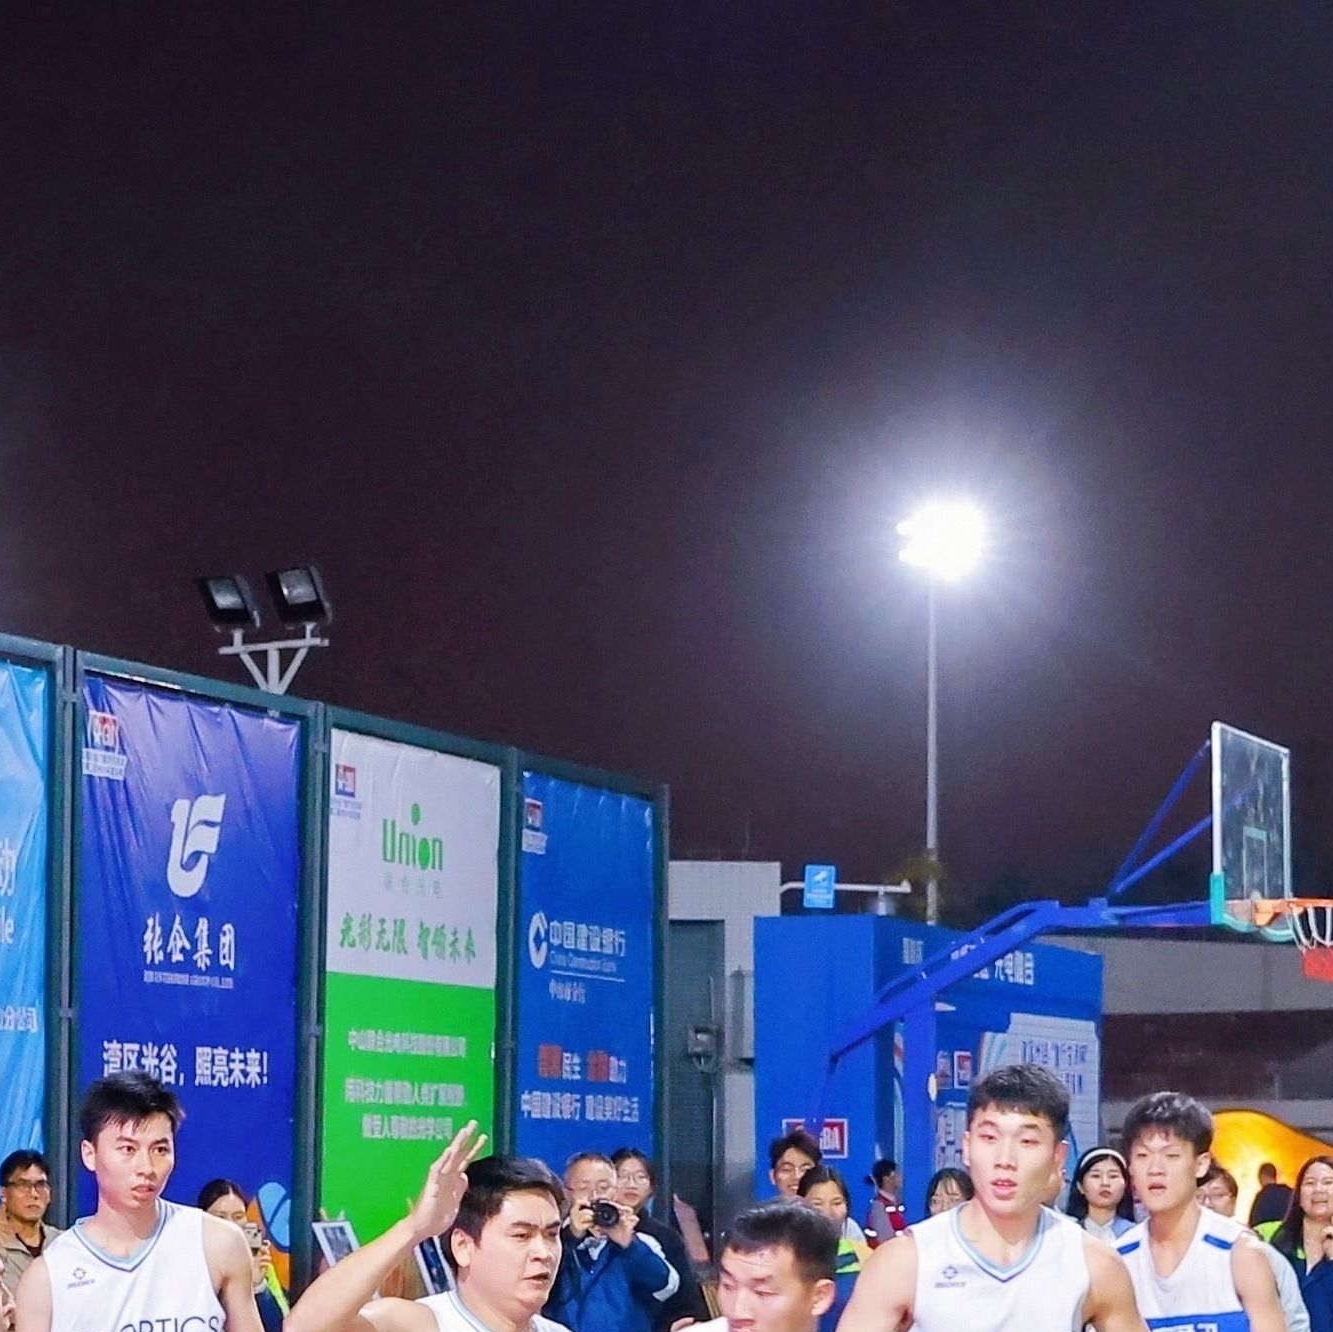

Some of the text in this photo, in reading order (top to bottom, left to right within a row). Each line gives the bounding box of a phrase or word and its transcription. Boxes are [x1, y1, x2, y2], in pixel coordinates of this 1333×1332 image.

[382, 802, 443, 871] Union
[549, 920, 626, 957] 中国建设银行
